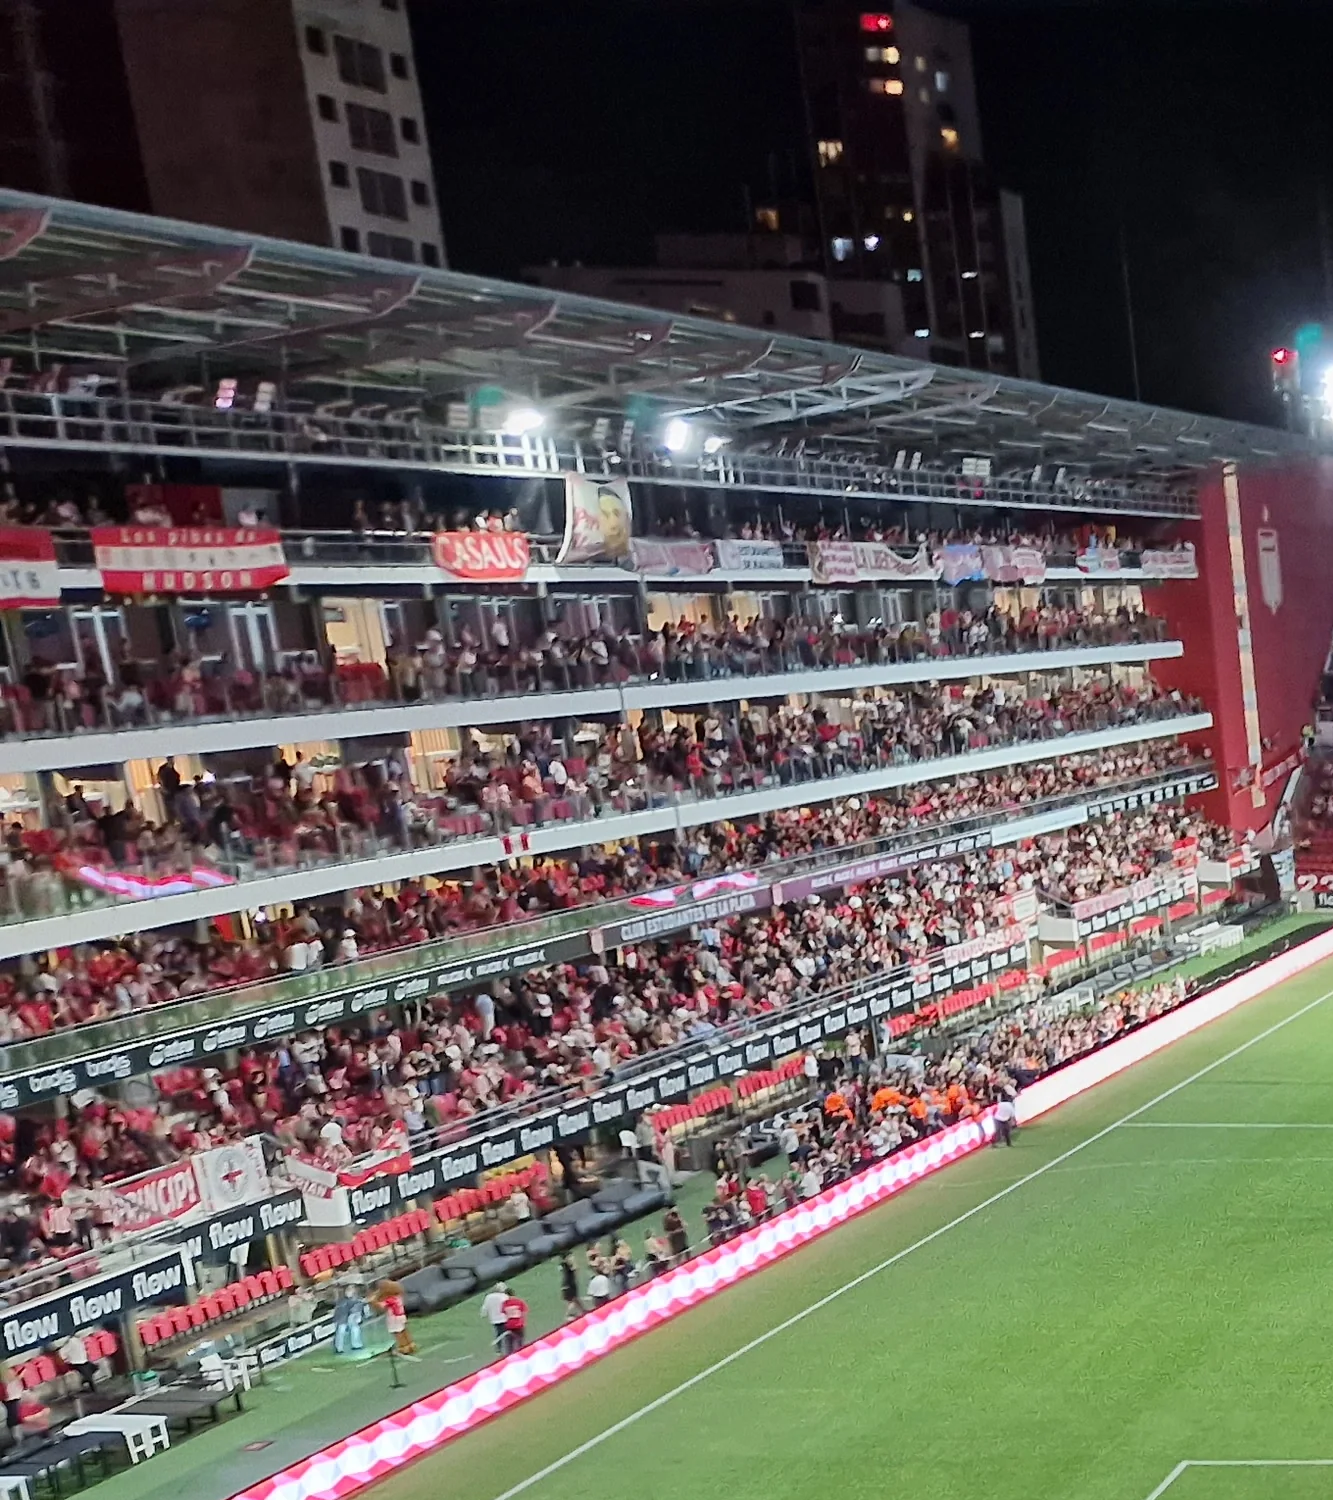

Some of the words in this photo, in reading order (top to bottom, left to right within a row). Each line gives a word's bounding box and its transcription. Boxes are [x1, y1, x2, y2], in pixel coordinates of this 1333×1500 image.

[352, 1186, 391, 1217] flow
[398, 1169, 435, 1199] flow
[441, 1153, 477, 1182] flow
[209, 1215, 254, 1250] flow
[260, 1198, 302, 1231] flow
[4, 1312, 59, 1351] flow
[69, 1288, 122, 1327] flow
[132, 1264, 181, 1302] flow
